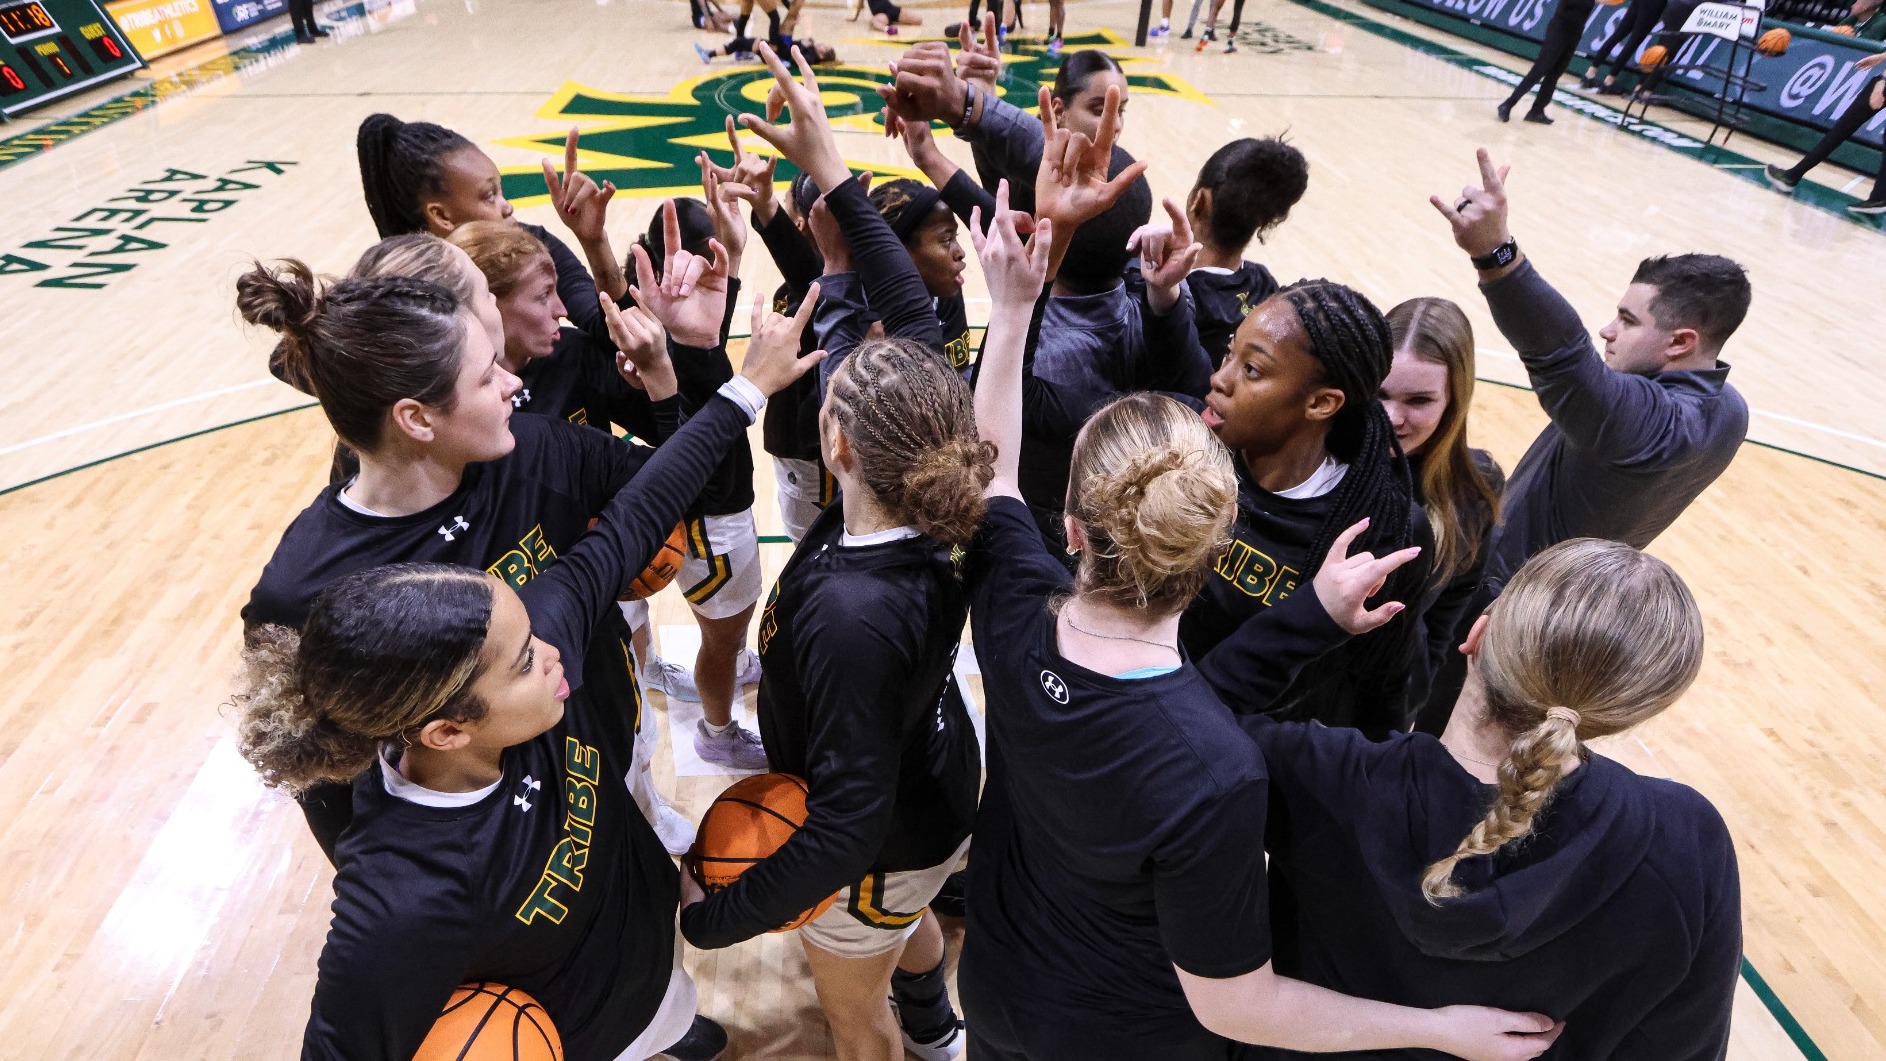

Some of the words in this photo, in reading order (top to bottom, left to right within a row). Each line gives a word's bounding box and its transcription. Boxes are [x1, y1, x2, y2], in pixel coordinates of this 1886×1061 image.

[0, 4, 52, 33] 11:18
[1700, 8, 1738, 21] WILLIAM
[102, 35, 122, 58] 0
[1, 65, 26, 90] 0
[0, 168, 209, 275] ARENA
[33, 160, 300, 290] KAPLAN
[1213, 539, 1300, 607] IBE
[515, 735, 600, 926] TRIBE
